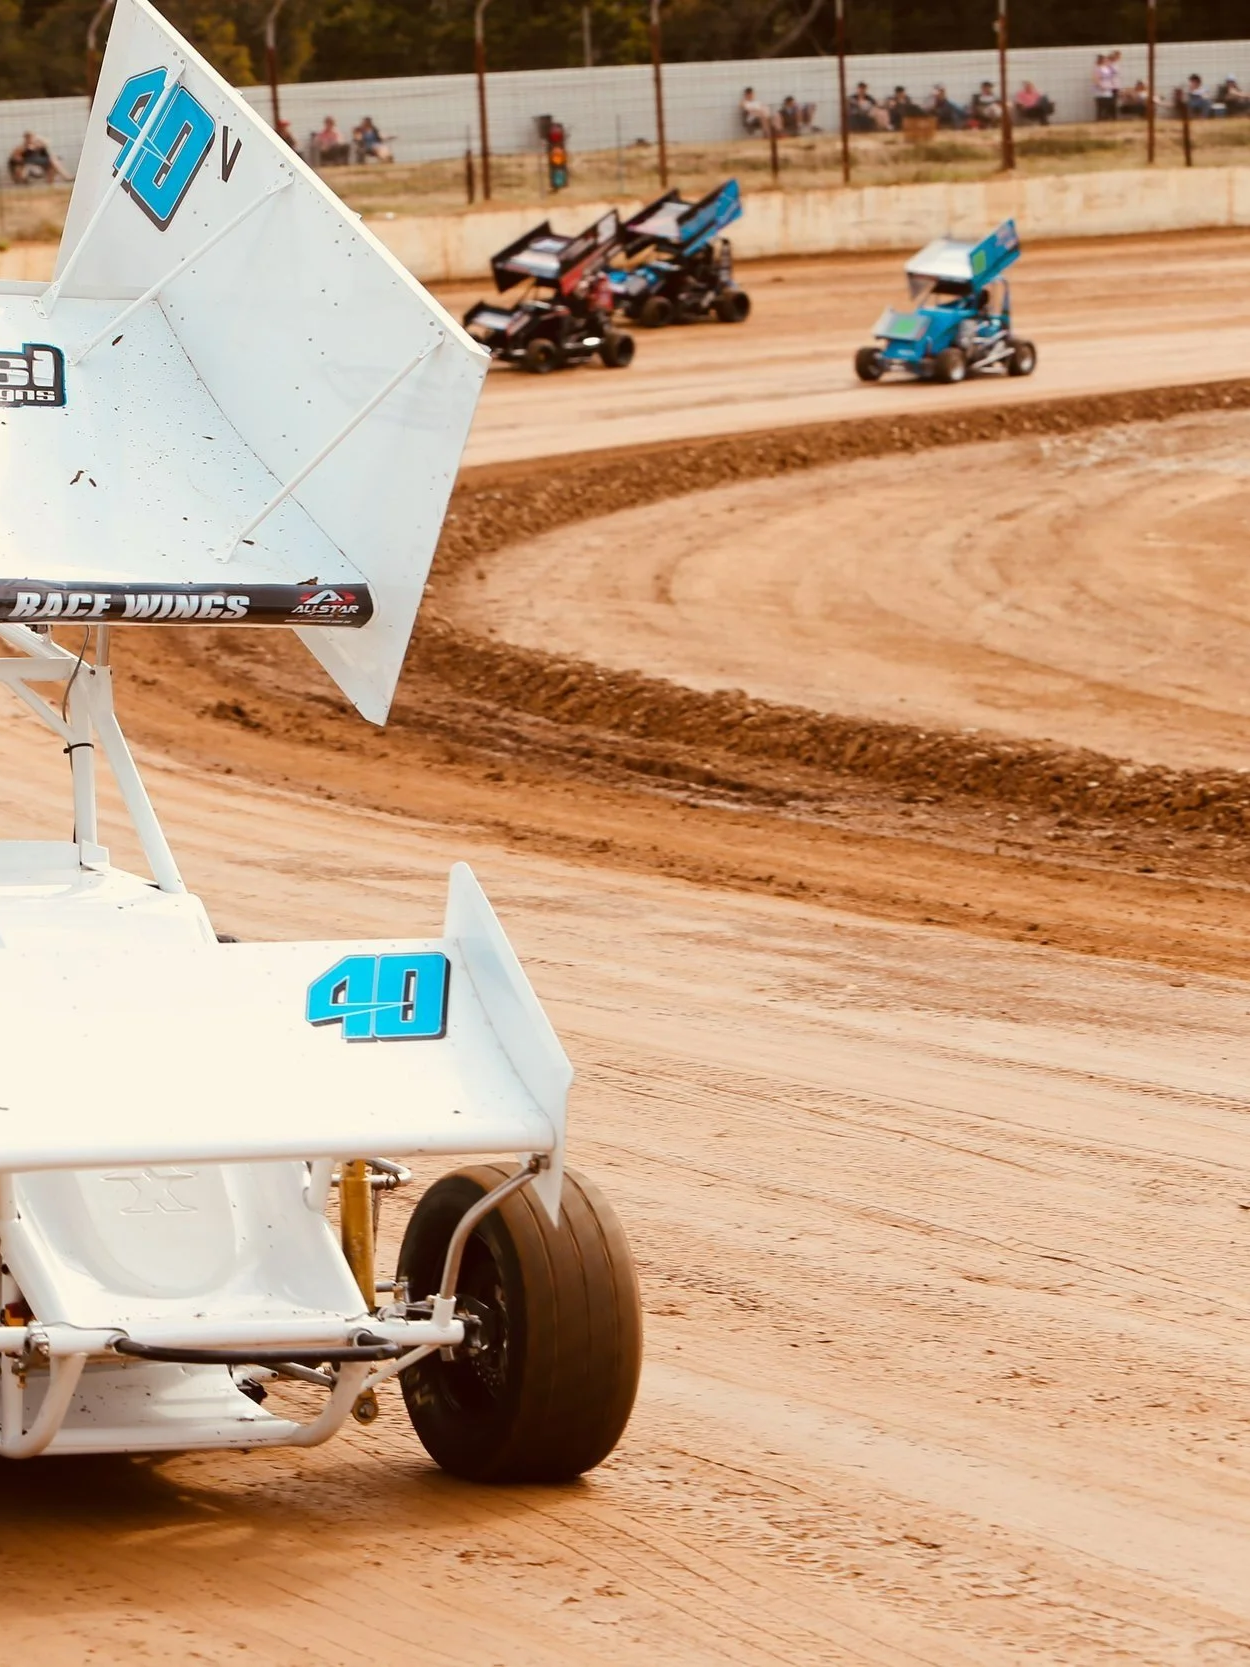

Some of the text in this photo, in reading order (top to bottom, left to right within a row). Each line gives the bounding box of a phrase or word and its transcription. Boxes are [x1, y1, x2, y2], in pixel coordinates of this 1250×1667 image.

[106, 66, 215, 232] 40
[8, 592, 112, 618] RACE
[121, 594, 250, 619] WINGS
[291, 604, 360, 614] ALLSTAR
[306, 952, 450, 1043] 40
